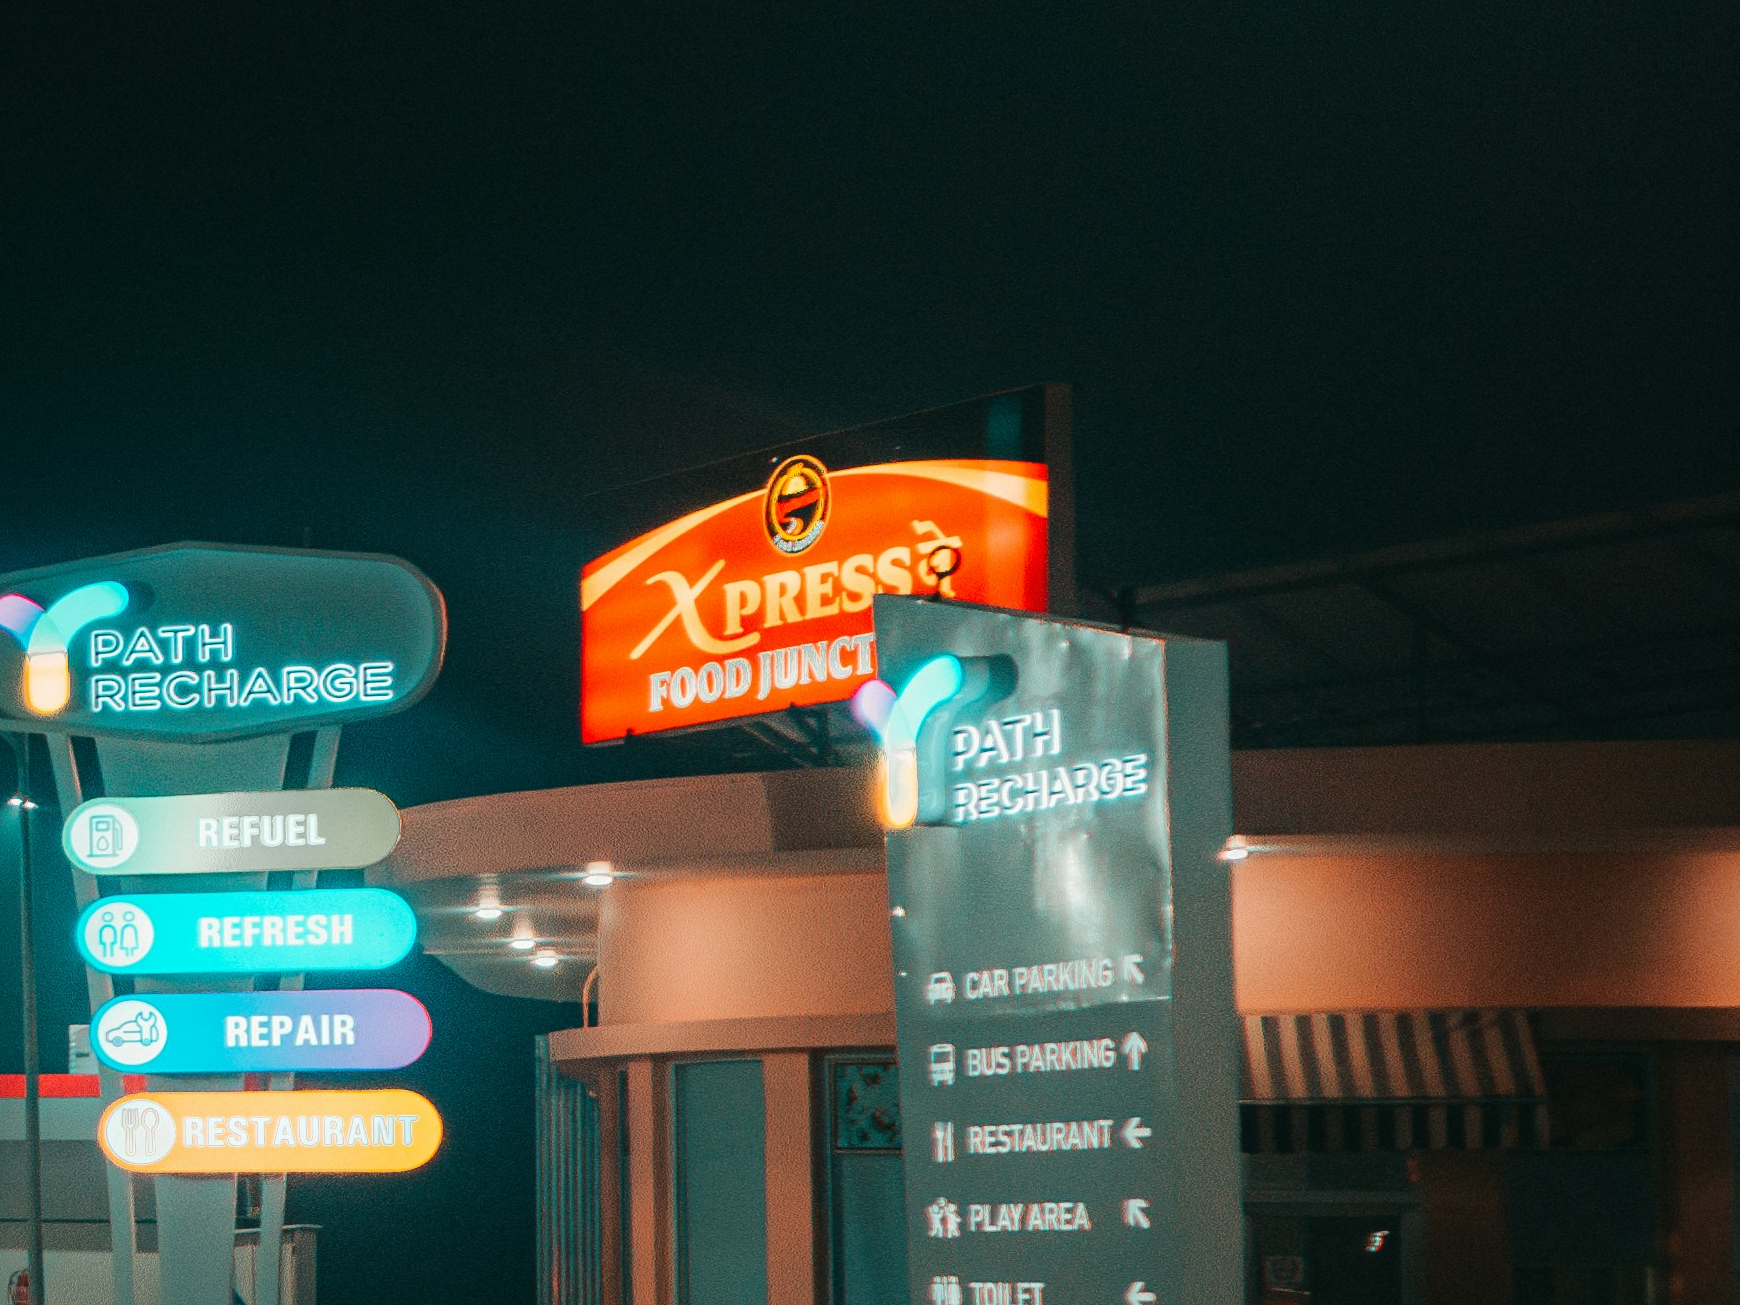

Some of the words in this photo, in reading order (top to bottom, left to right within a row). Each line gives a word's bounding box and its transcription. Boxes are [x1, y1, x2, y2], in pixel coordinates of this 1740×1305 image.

[630, 545, 912, 660] XPRESS
[90, 622, 234, 668] PATH
[90, 661, 395, 713] RECHARGE
[648, 656, 753, 713] FOOD
[952, 708, 1062, 772] PATH
[952, 752, 1149, 824] RECHARGE
[198, 813, 327, 848] REFUEL
[198, 913, 355, 948] REFRESH
[965, 968, 1010, 999] CAR
[1012, 958, 1115, 994] PARKING
[225, 1013, 356, 1048] REPAIR
[966, 1045, 1012, 1076] BUS
[1014, 1037, 1117, 1073] PARKING
[182, 1114, 420, 1148] RESTAURANT
[967, 1119, 1115, 1154] RESTAURANT
[968, 1203, 1025, 1232] PLAY
[1026, 1202, 1092, 1231] AREA
